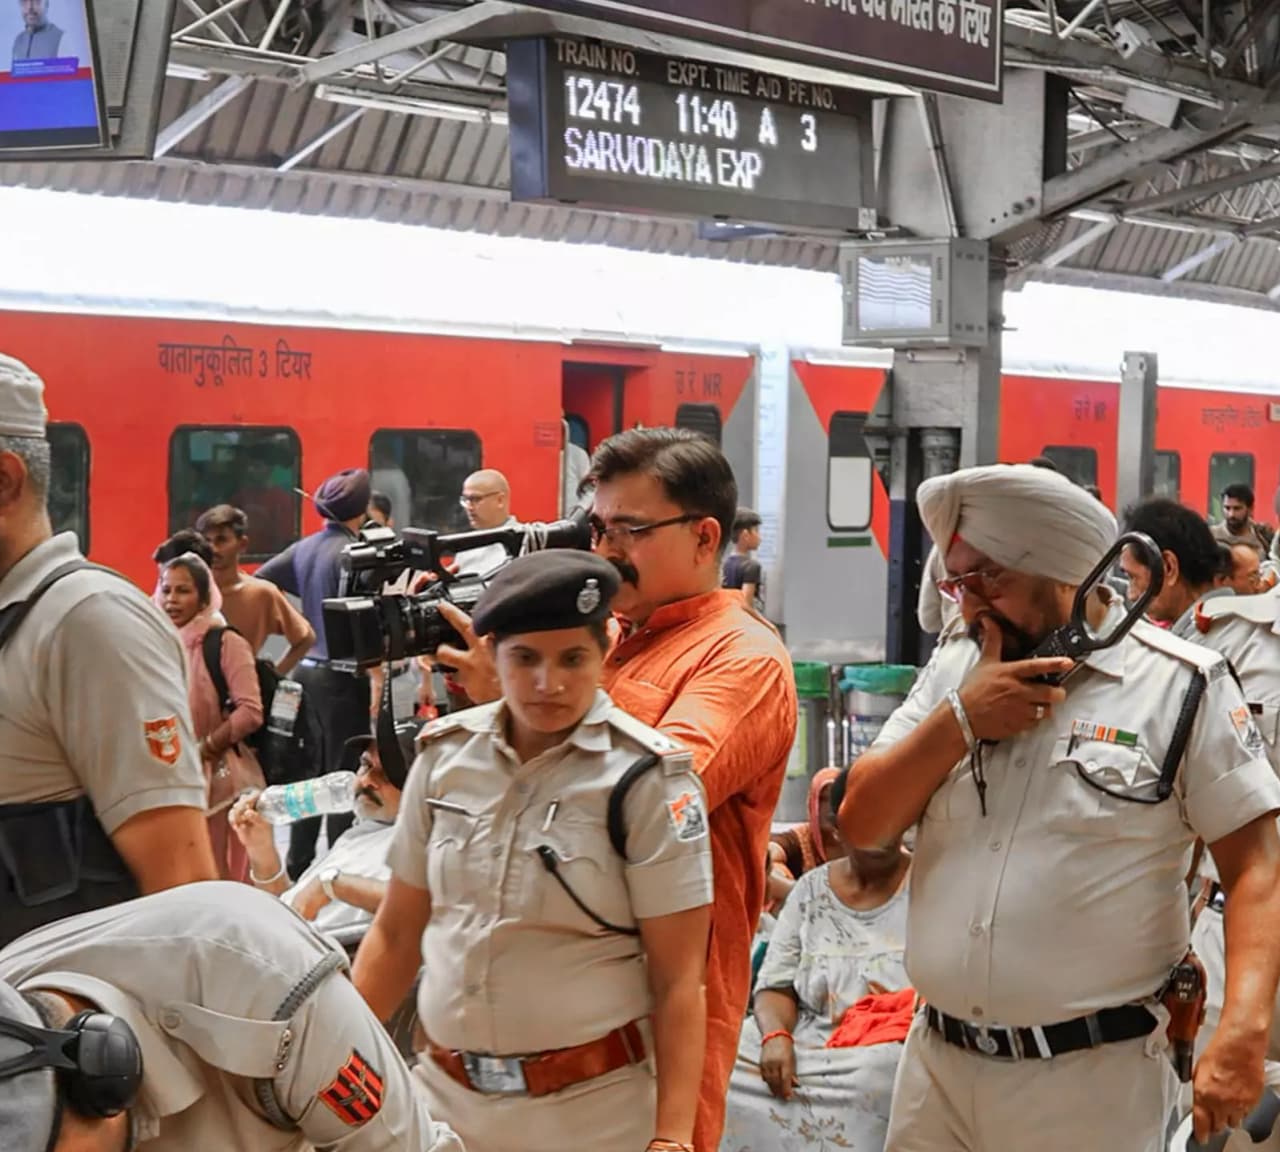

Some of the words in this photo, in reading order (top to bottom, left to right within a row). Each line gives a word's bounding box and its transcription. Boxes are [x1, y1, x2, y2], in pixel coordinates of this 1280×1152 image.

[556, 39, 607, 66] TRAIN
[611, 51, 640, 77] NO.
[667, 61, 711, 88] EXPT.
[716, 67, 750, 95] TIME
[788, 78, 809, 104] PF.
[811, 83, 837, 110] NO.
[565, 75, 640, 126] 12474
[675, 92, 738, 140] 11:40
[758, 107, 778, 146] A
[800, 114, 818, 151] 3
[564, 127, 712, 184] SARVODAYA
[716, 148, 762, 190] EXP
[158, 334, 253, 387] वातानुकूलित
[259, 350, 268, 378] 3
[276, 338, 312, 380] टियर
[703, 373, 720, 396] NR
